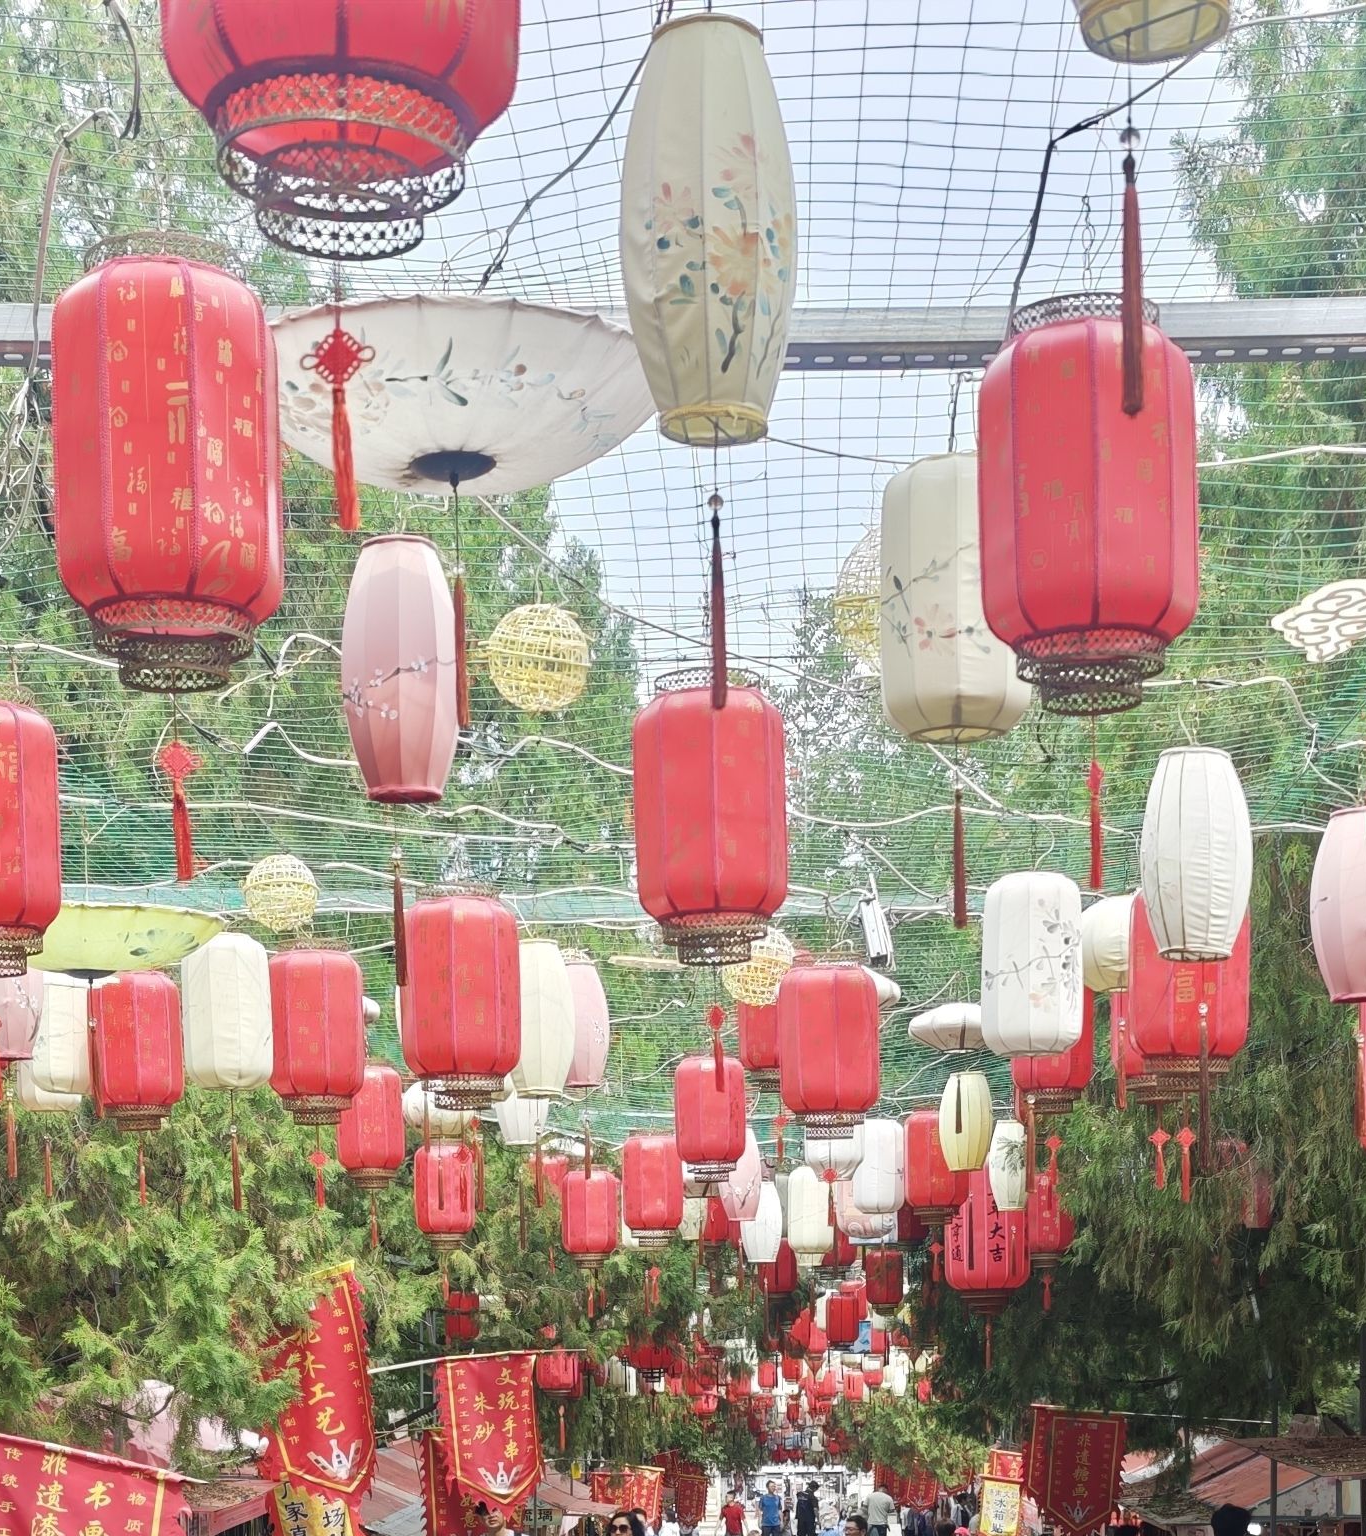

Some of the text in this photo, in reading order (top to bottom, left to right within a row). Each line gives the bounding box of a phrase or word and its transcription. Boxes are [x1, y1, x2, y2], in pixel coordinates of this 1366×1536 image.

[473, 1391, 496, 1445] 朱砂
[495, 1367, 520, 1464] 文玩手串
